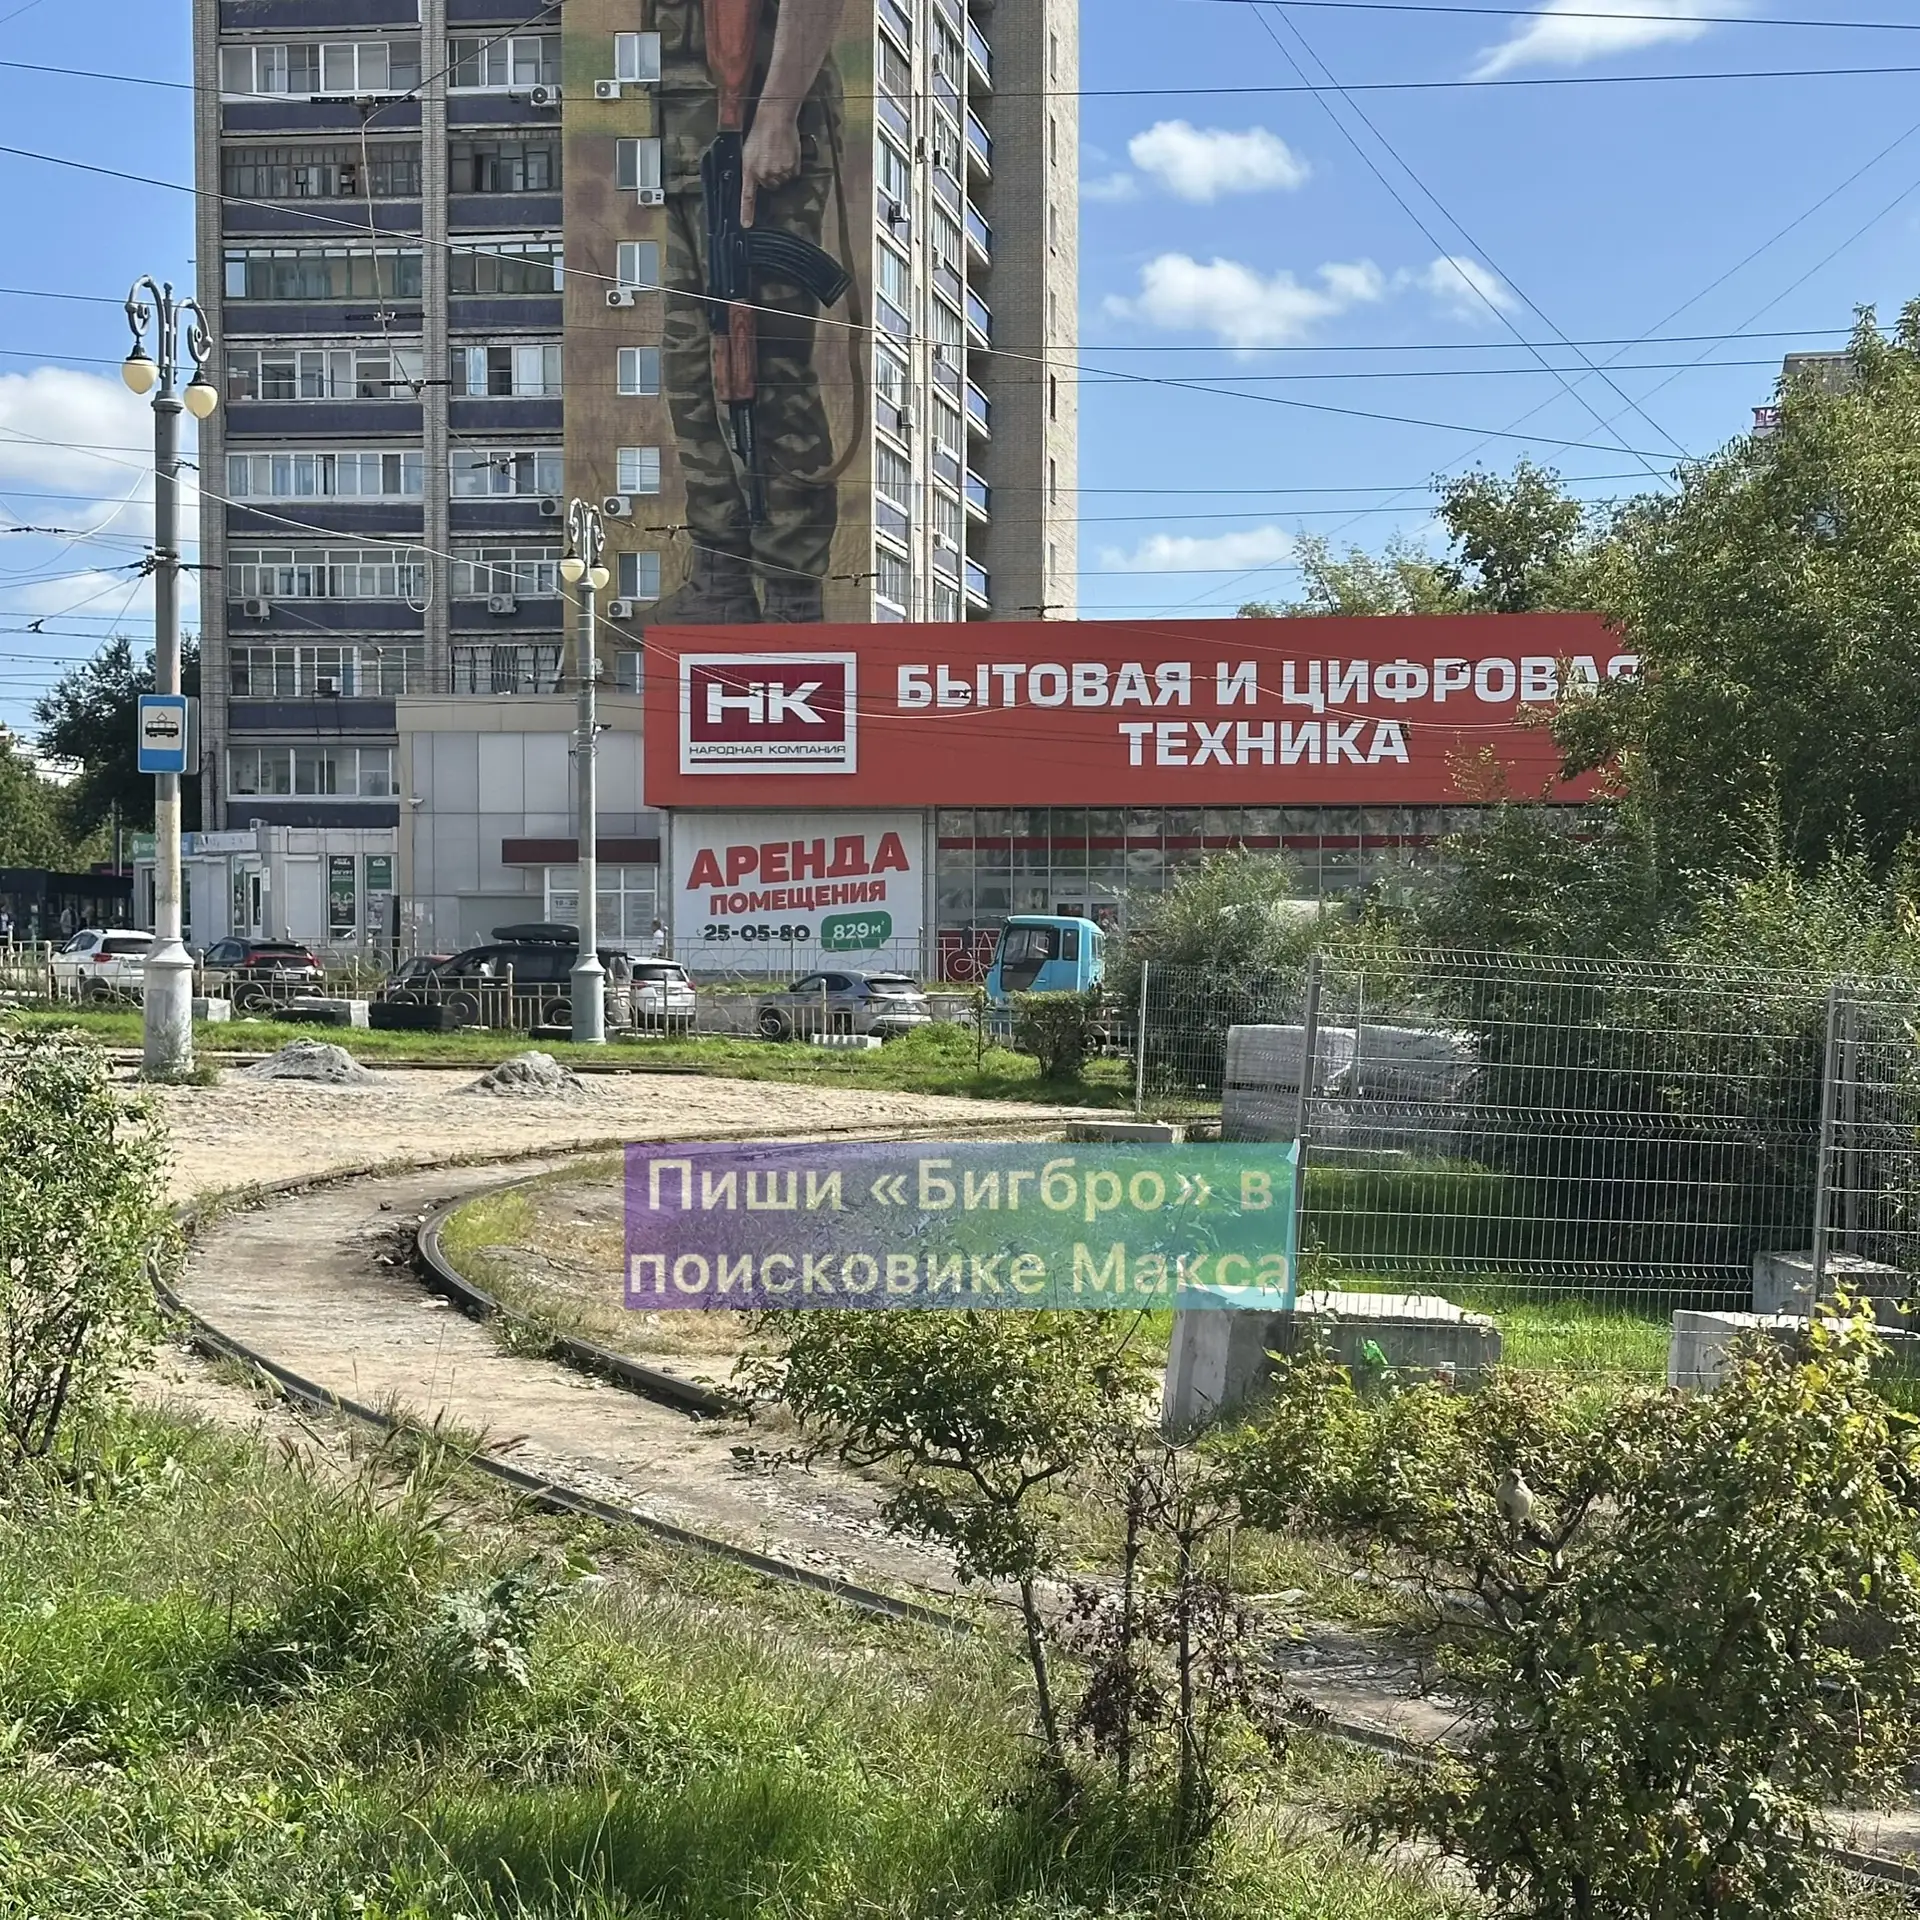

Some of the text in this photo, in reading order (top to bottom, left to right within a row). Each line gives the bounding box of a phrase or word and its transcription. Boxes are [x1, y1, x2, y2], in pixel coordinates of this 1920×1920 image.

[706, 682, 826, 724] НК
[897, 660, 1192, 709] БЫТОВАЯ
[1216, 660, 1258, 706] И
[689, 745, 846, 756] НАРОДНАЯ КОМПАНИЯ
[1118, 719, 1411, 767] ТЕХНИКА
[686, 831, 911, 890] АРЕНДА
[709, 879, 887, 916] ПОМЕЩЕНИЯ
[703, 923, 812, 943] 25-05-80
